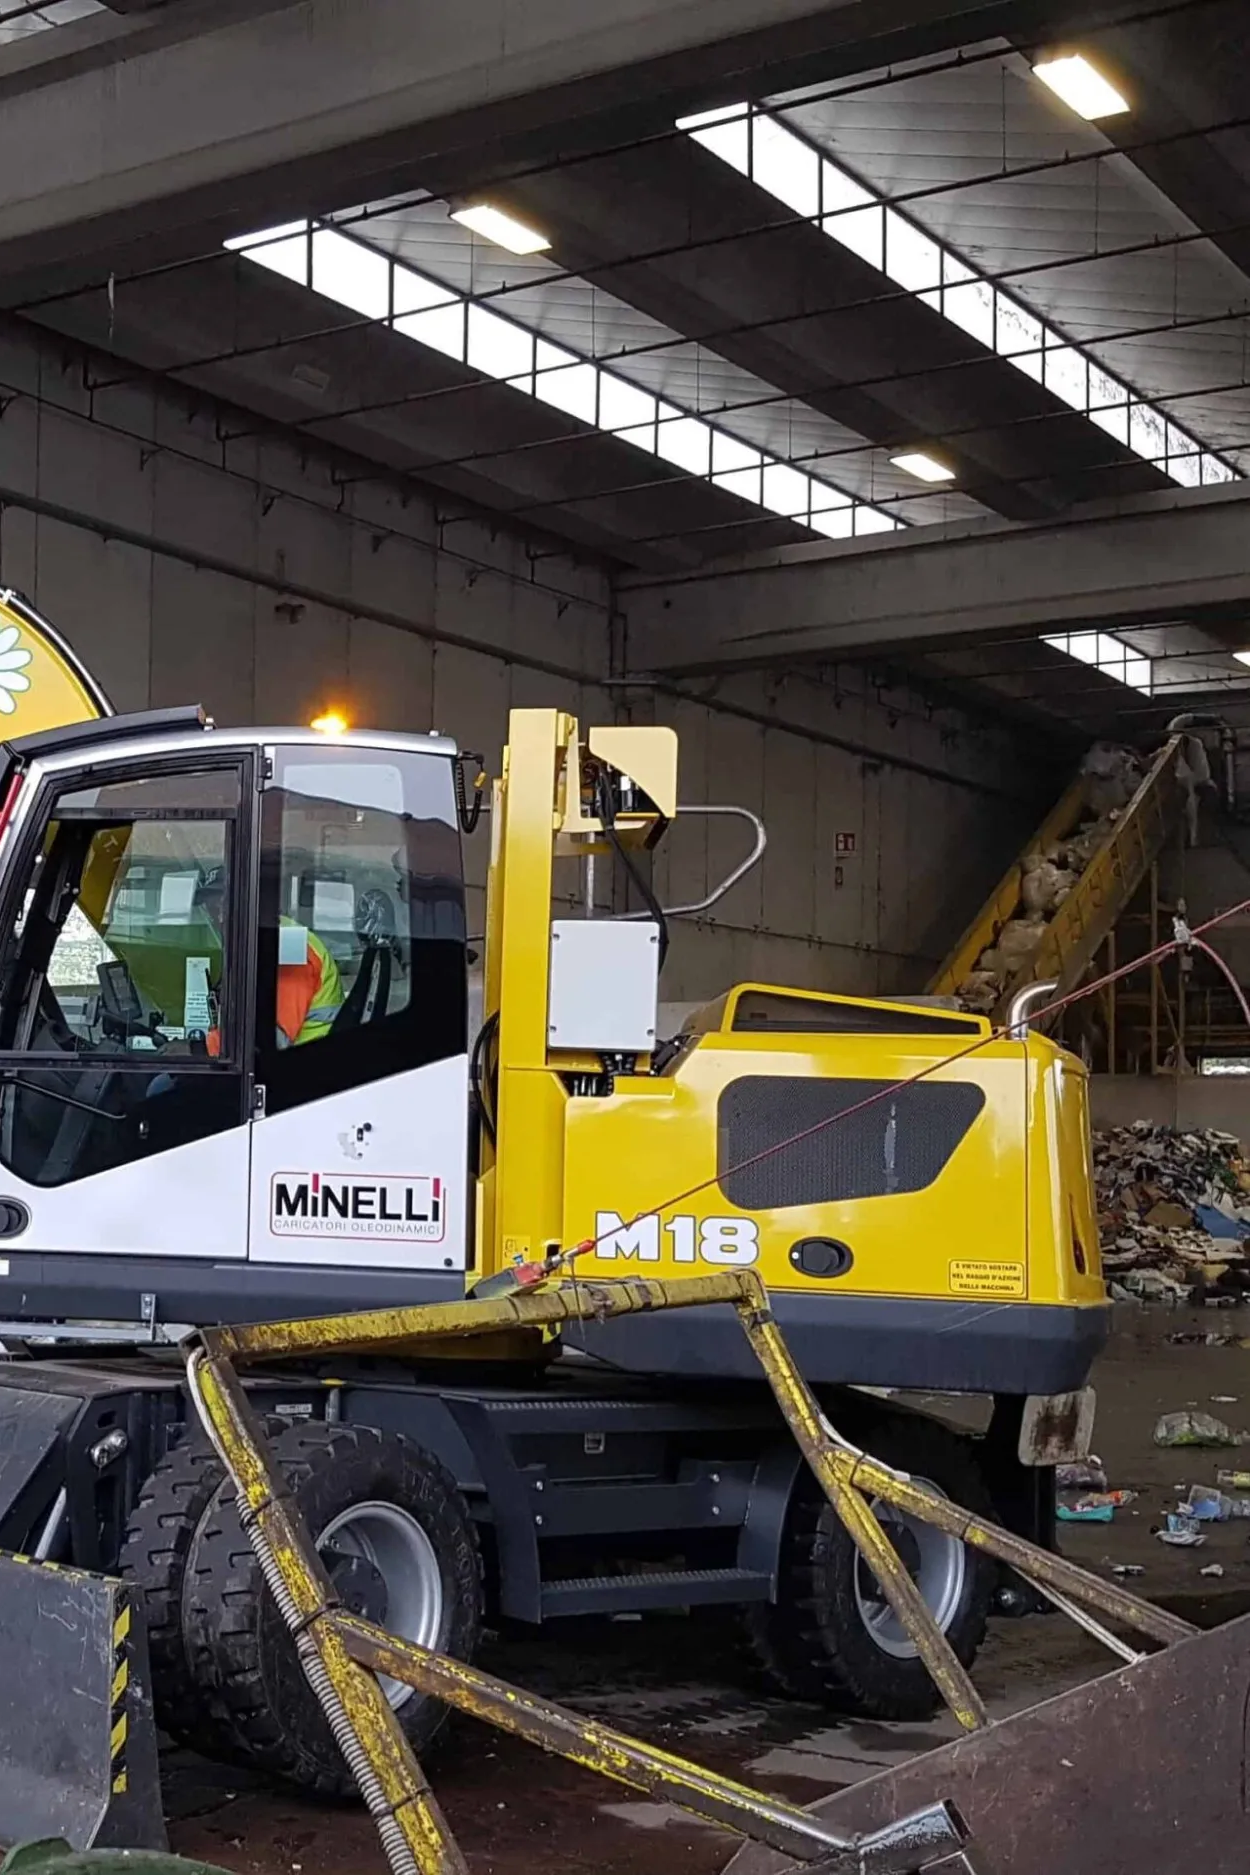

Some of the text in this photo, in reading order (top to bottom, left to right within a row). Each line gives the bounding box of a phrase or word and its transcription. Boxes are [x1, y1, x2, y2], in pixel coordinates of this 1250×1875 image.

[273, 1219, 440, 1235] CARICATORI OLEODINAMICI
[596, 1211, 759, 1265] M18
